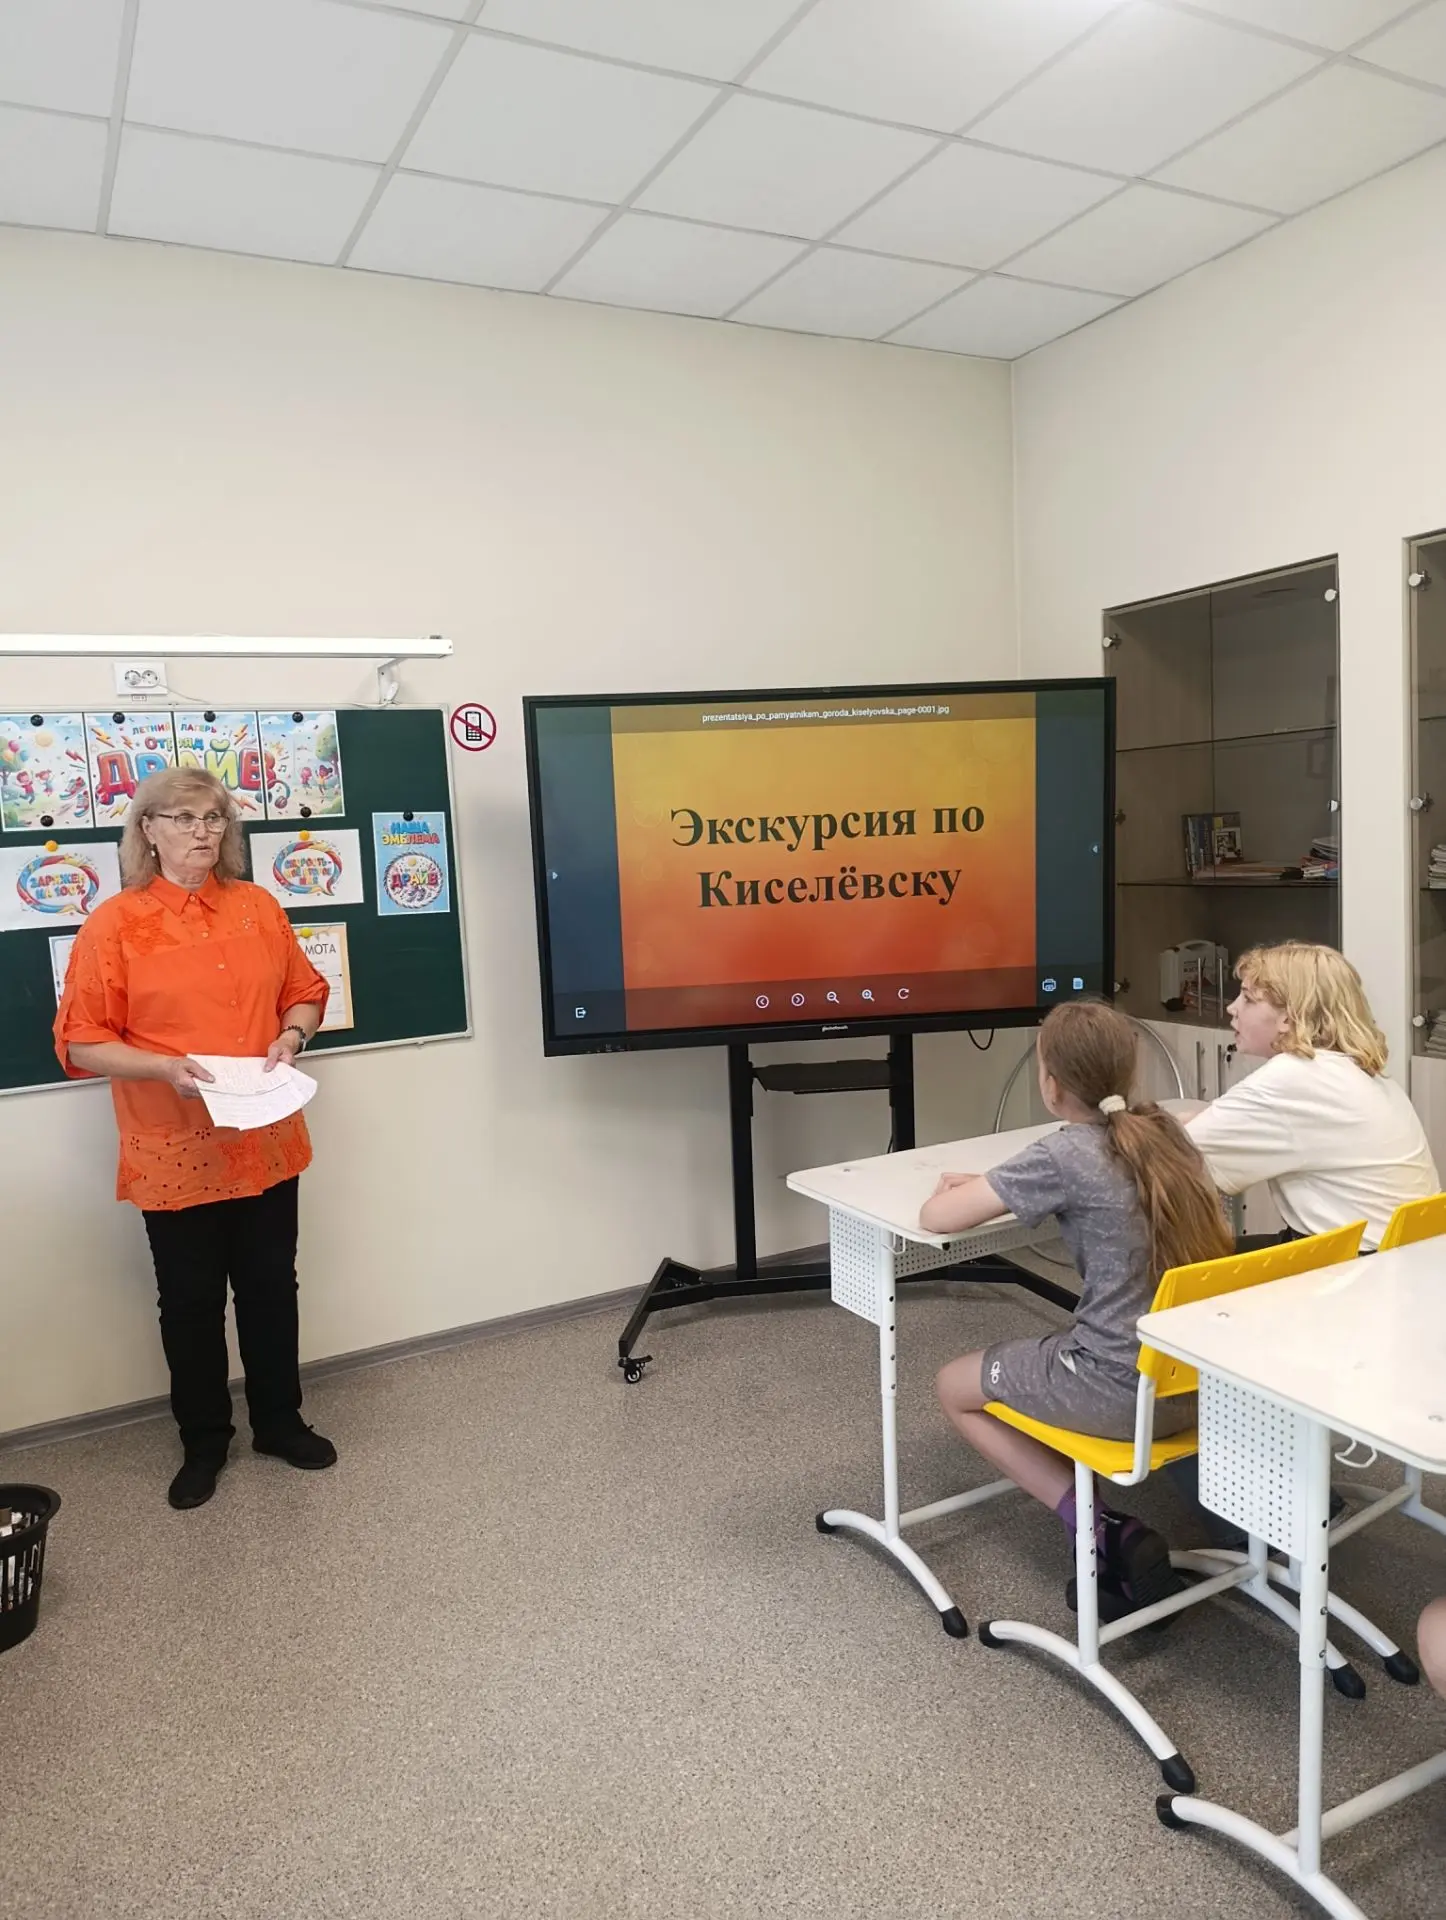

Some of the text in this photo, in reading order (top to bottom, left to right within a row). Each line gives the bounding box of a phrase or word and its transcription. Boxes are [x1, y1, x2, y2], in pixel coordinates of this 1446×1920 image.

[132, 723, 217, 735] ЛЕТНИЙ ЛАГЕРЬ
[391, 821, 430, 834] НАША
[671, 806, 985, 852] Экскурсия по
[382, 832, 440, 845] ЭМБЛЕМА
[392, 870, 438, 890] ДРАЙВ
[697, 866, 962, 908] Киселёвску
[304, 943, 337, 956] МОТА
